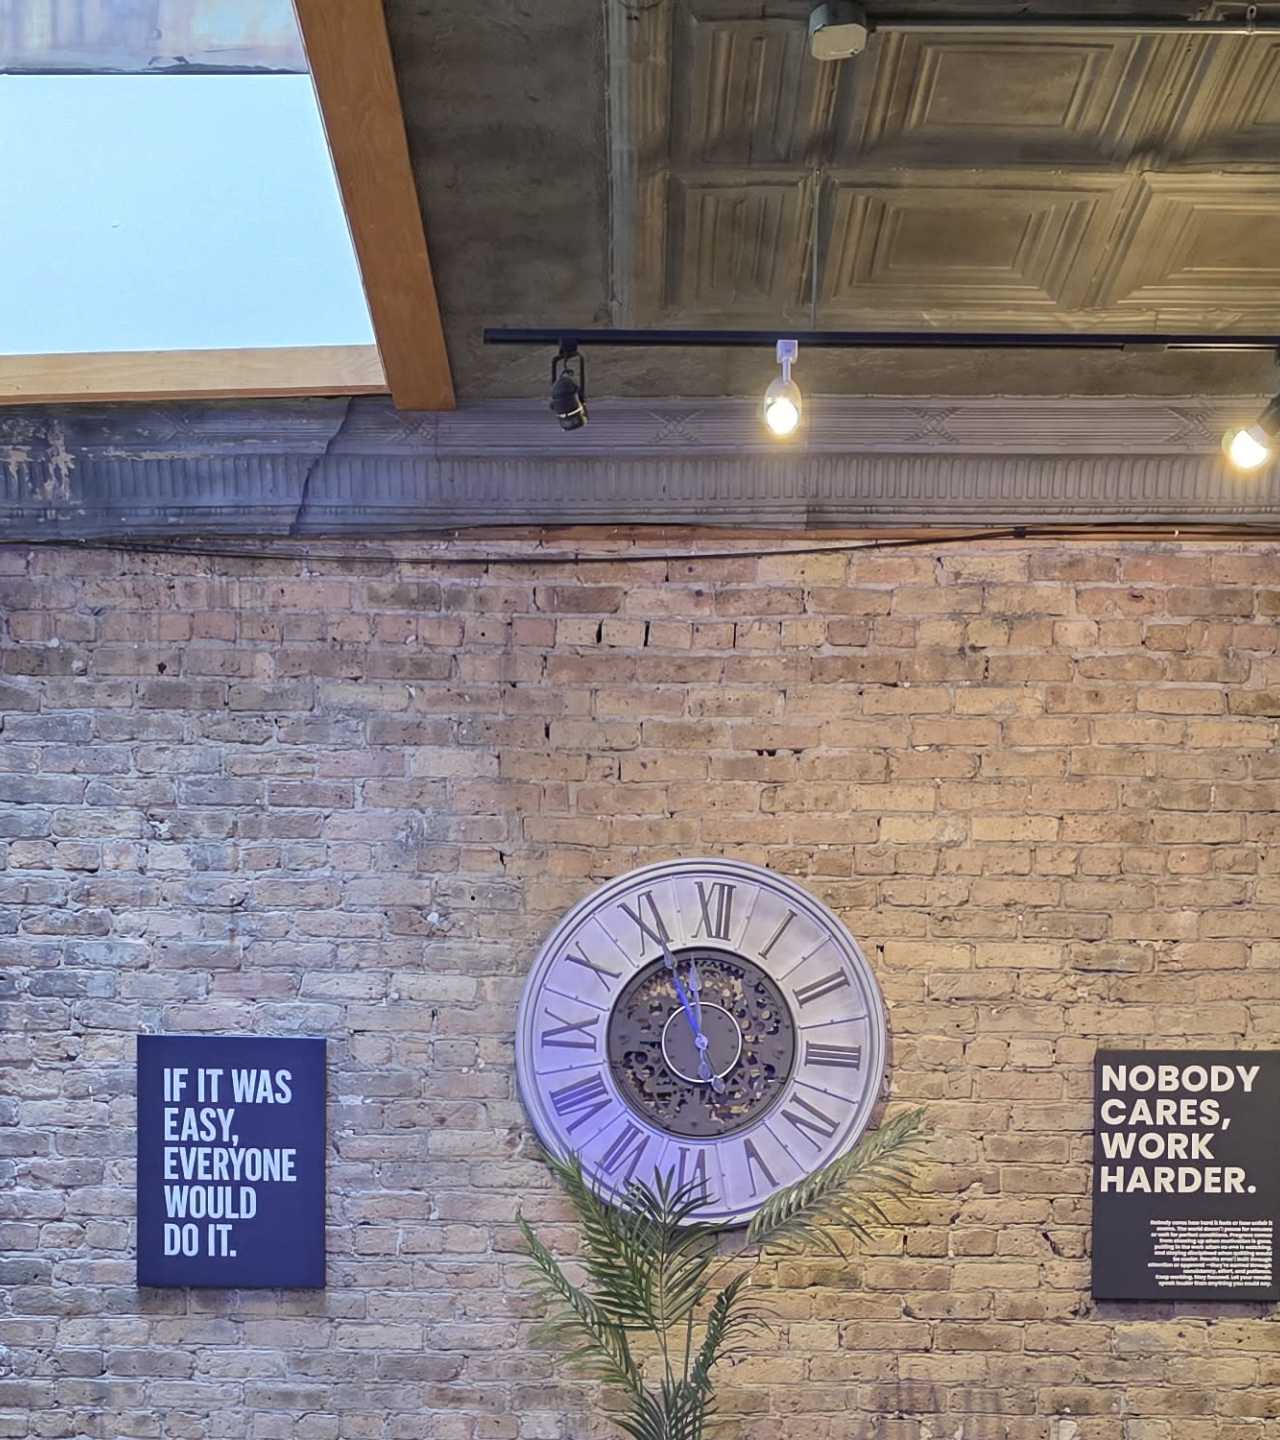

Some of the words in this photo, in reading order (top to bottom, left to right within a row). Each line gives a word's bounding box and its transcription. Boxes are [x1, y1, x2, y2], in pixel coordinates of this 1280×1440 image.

[690, 881, 737, 942] XII
[564, 940, 623, 993] X
[541, 1008, 601, 1053] IX
[163, 1068, 189, 1102] IF
[197, 1068, 224, 1103] IT
[231, 1069, 292, 1104] WAS
[1101, 1065, 1260, 1092] NOBODY
[164, 1108, 239, 1146] EASY,
[1100, 1099, 1231, 1130] CARES,
[1100, 1132, 1215, 1160] WORK
[164, 1147, 297, 1182] EVERYONE
[1100, 1166, 1257, 1193] HARDER.
[164, 1185, 257, 1219] WOULD
[164, 1224, 199, 1257] DO
[207, 1224, 237, 1257] IT.
